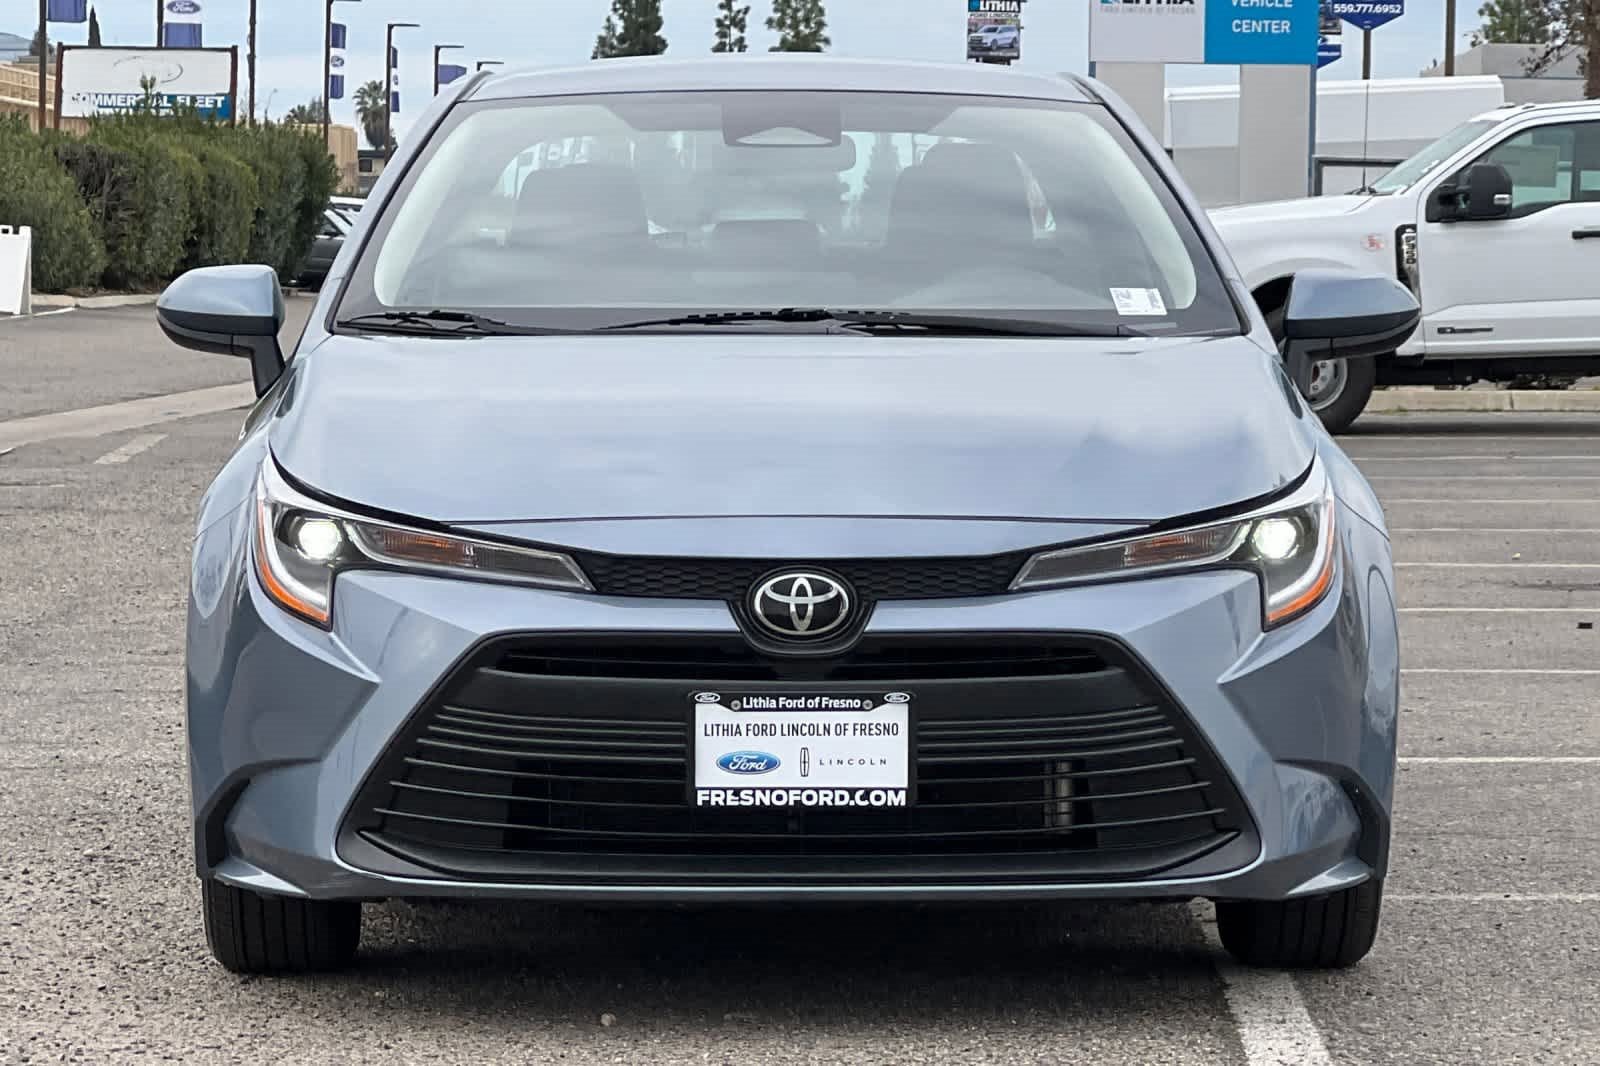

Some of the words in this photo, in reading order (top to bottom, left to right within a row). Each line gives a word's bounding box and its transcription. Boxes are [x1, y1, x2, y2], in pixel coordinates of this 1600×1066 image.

[980, 0, 1019, 11] LITHIA
[1333, 3, 1402, 13] 559.777.6952
[1232, 20, 1291, 34] CENTER
[742, 696, 777, 709] Lithia
[779, 696, 805, 709] Ford
[806, 696, 821, 709] of
[821, 696, 861, 709] Fresno
[704, 722, 742, 737] LITHIA
[746, 722, 777, 737] FORD
[780, 722, 831, 737] LINCOLN
[834, 722, 849, 737] OF
[853, 722, 899, 737] FRESNO
[819, 758, 887, 766] LINCOLN
[696, 789, 906, 806] FRESNOFORD.COM
